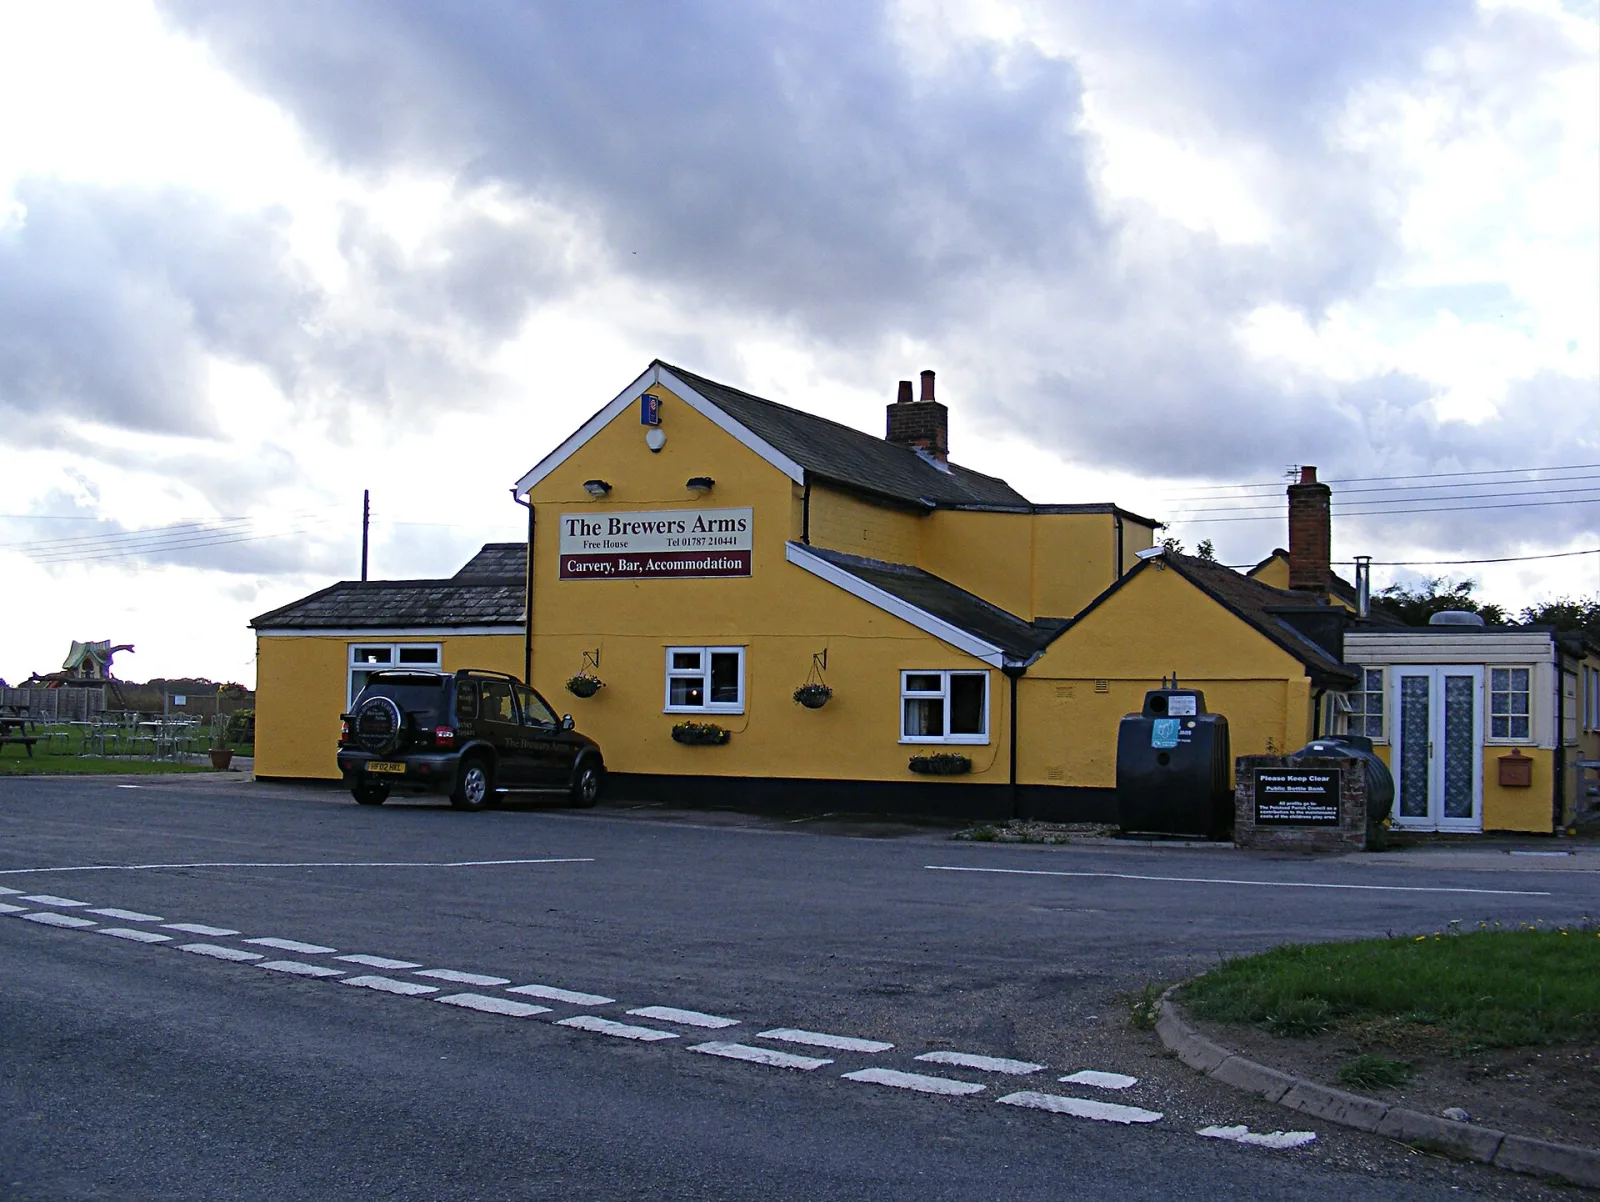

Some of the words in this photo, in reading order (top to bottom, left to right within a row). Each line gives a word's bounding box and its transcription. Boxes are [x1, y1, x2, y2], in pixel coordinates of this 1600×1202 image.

[566, 518, 602, 537] The
[608, 516, 686, 536] Brewers
[691, 514, 747, 533] Arms
[583, 540, 601, 549] Free
[603, 539, 629, 549] House
[666, 537, 680, 547] Tel
[681, 536, 706, 547] 01787
[708, 536, 738, 546] 210441
[567, 559, 615, 575] Carvery,
[618, 558, 643, 574] Bar,
[645, 556, 743, 571] Accommodation
